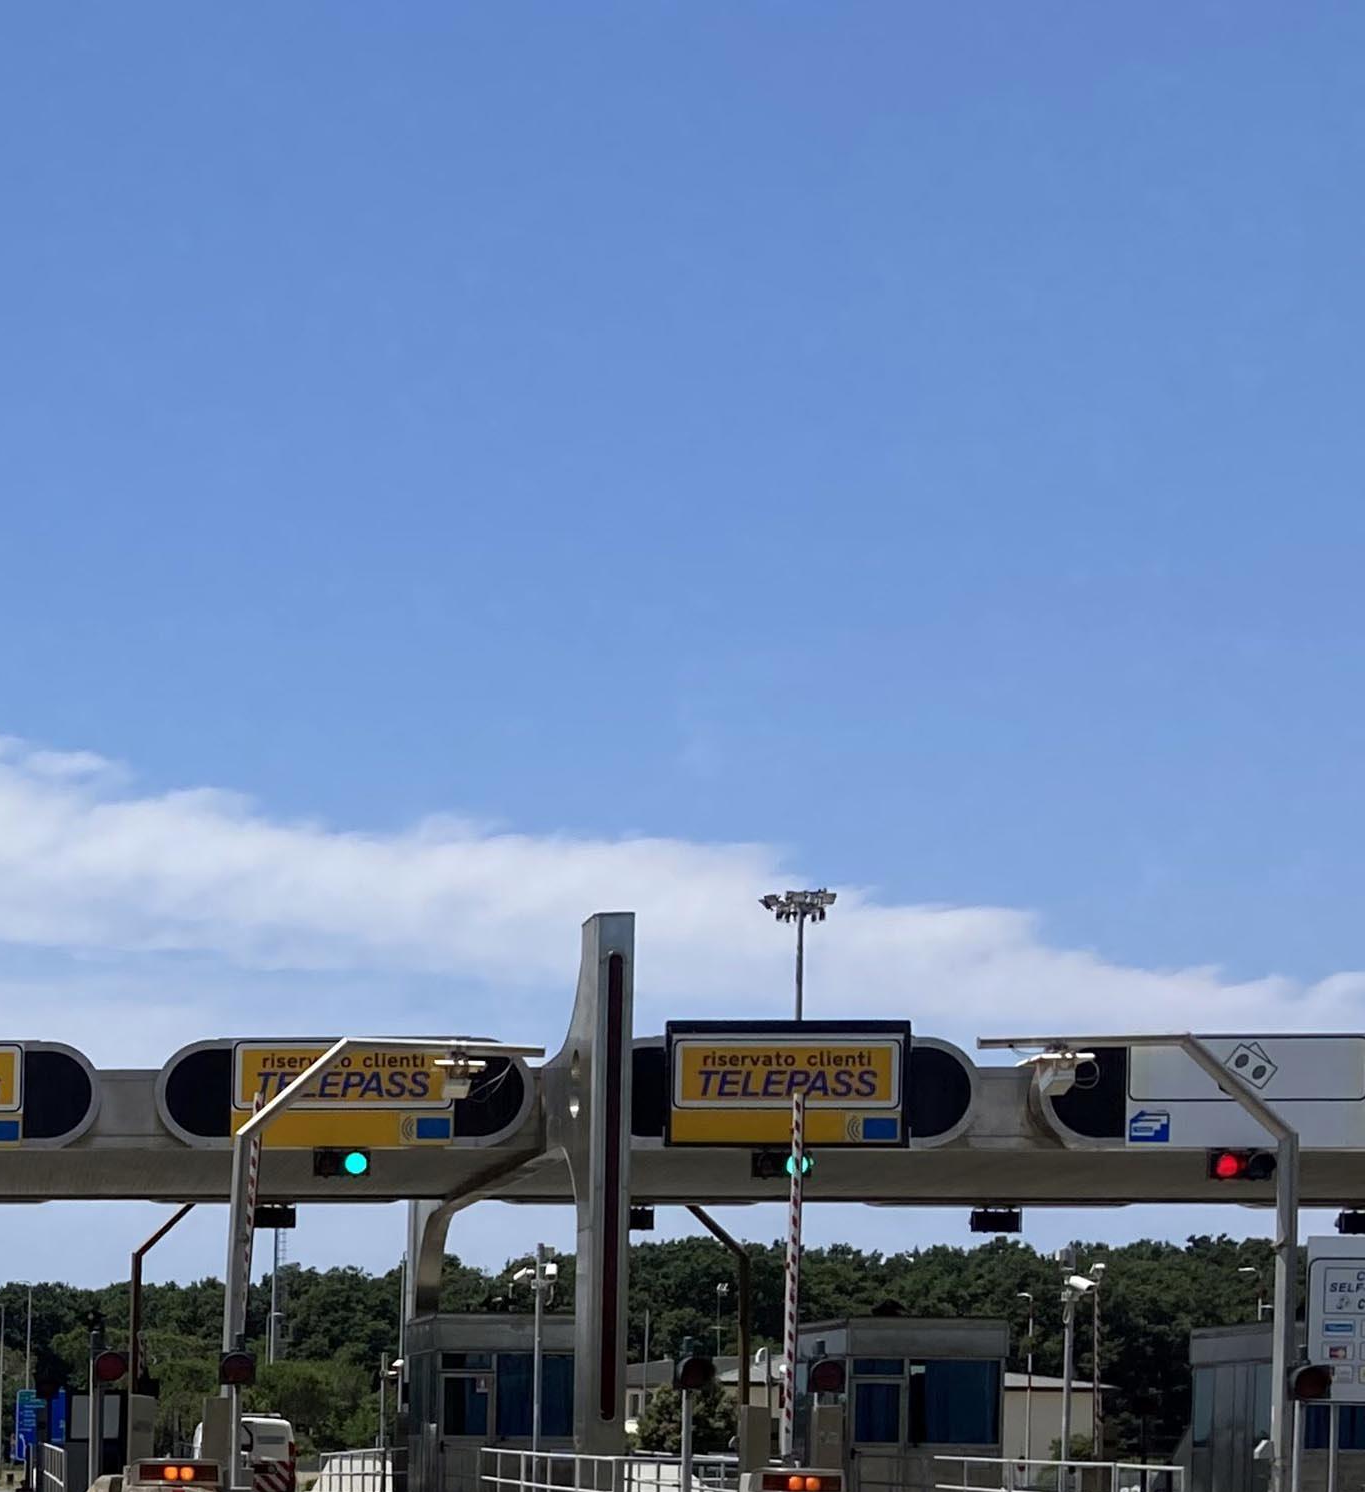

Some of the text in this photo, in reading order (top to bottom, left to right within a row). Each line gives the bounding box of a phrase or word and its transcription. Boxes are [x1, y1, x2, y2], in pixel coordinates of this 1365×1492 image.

[262, 1053, 425, 1068] riservo clienti
[702, 1050, 872, 1067] riservato clienti
[698, 1069, 878, 1097] TELEPASS
